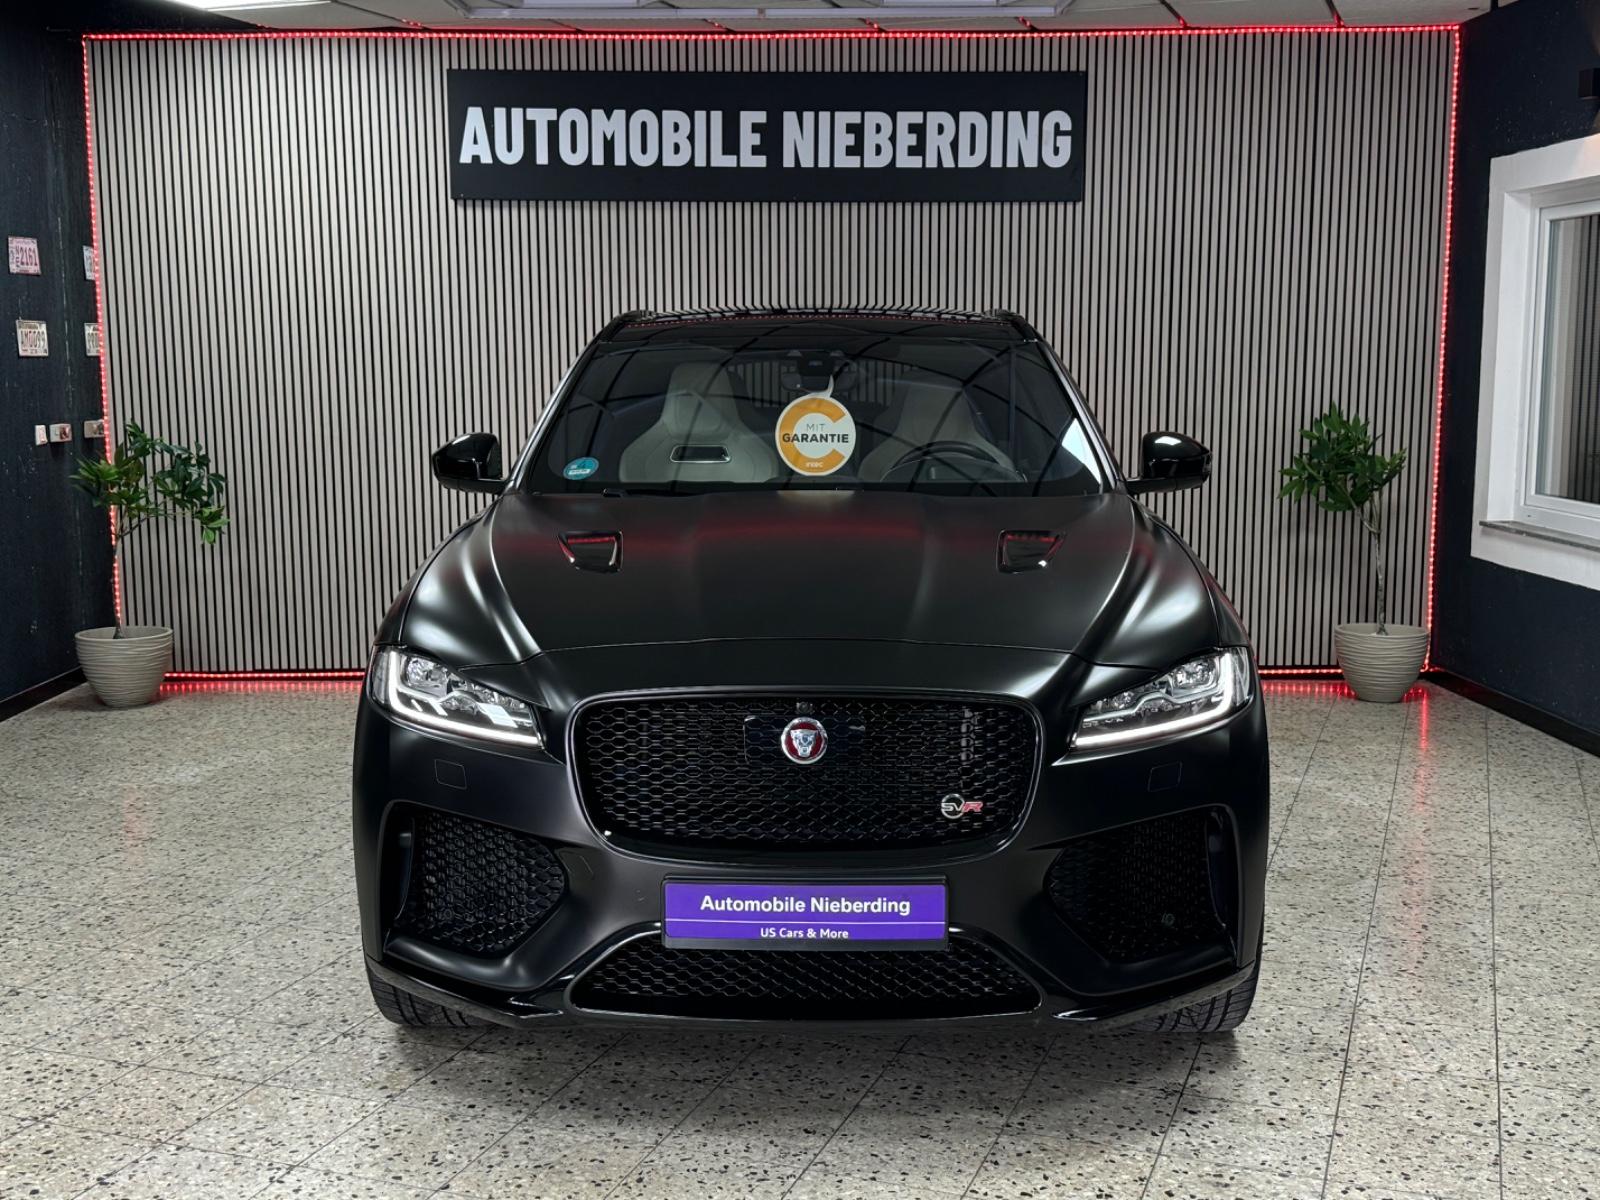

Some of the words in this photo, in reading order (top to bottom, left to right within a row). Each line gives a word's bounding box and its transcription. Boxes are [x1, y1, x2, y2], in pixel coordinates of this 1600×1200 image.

[459, 107, 767, 167] AUTOMOBILE
[782, 110, 1072, 168] NIEBERDING
[806, 423, 826, 432] MIT
[782, 433, 849, 443] GARANTIE
[941, 800, 984, 815] SVR
[700, 895, 806, 913] Automobile
[810, 896, 911, 916] Nieberding
[760, 927, 777, 938] US
[779, 927, 804, 938] Cars
[807, 928, 817, 938] &
[819, 928, 849, 939] More
